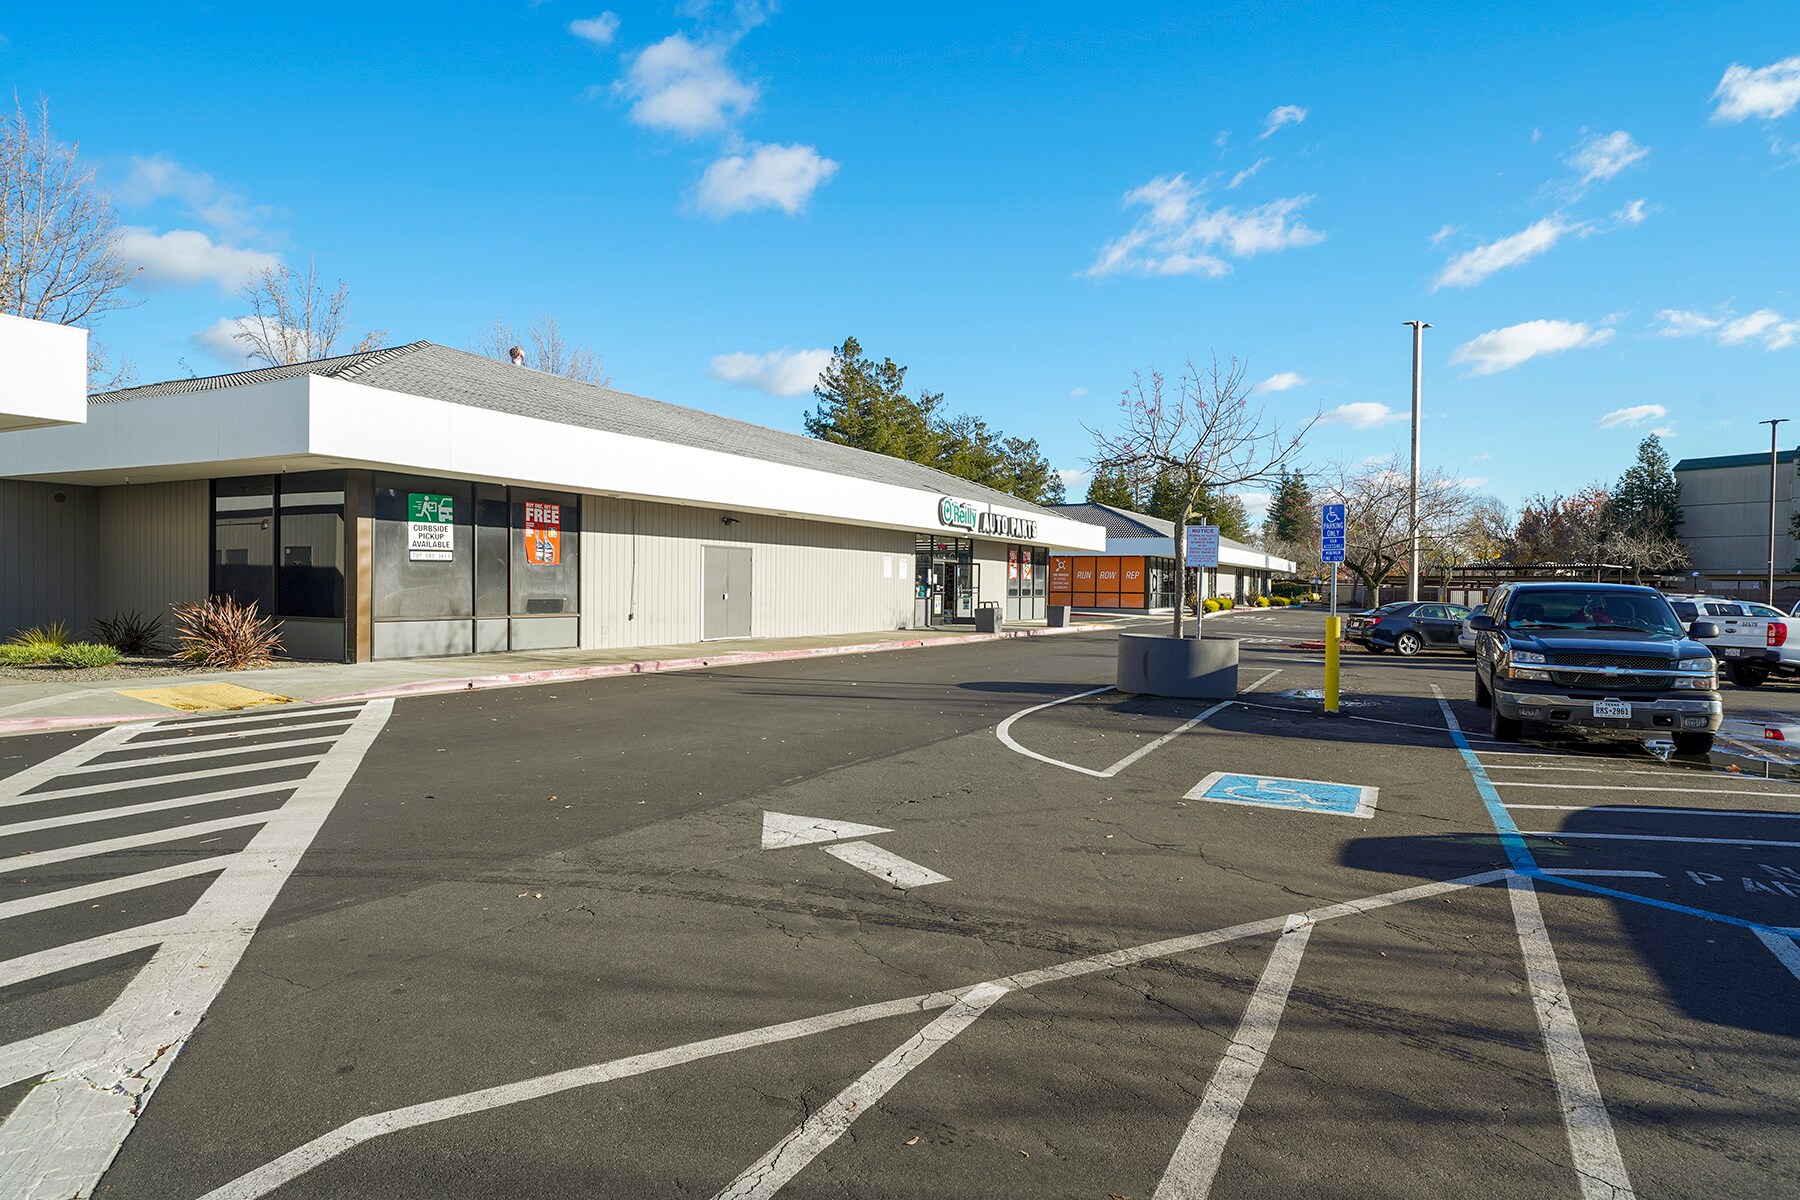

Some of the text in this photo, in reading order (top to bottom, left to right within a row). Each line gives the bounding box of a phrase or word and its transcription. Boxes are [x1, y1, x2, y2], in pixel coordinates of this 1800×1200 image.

[526, 508, 560, 525] FREE
[943, 499, 1037, 539] O'Reilly AUTO PARTS
[413, 524, 449, 533] CURBSIDE
[1323, 522, 1343, 530] PARKING
[418, 532, 445, 541] PICKUP
[412, 540, 450, 549] AVAILABLE
[1077, 571, 1092, 579] RUN
[1100, 571, 1117, 579] ROW
[1125, 571, 1140, 580] REP
